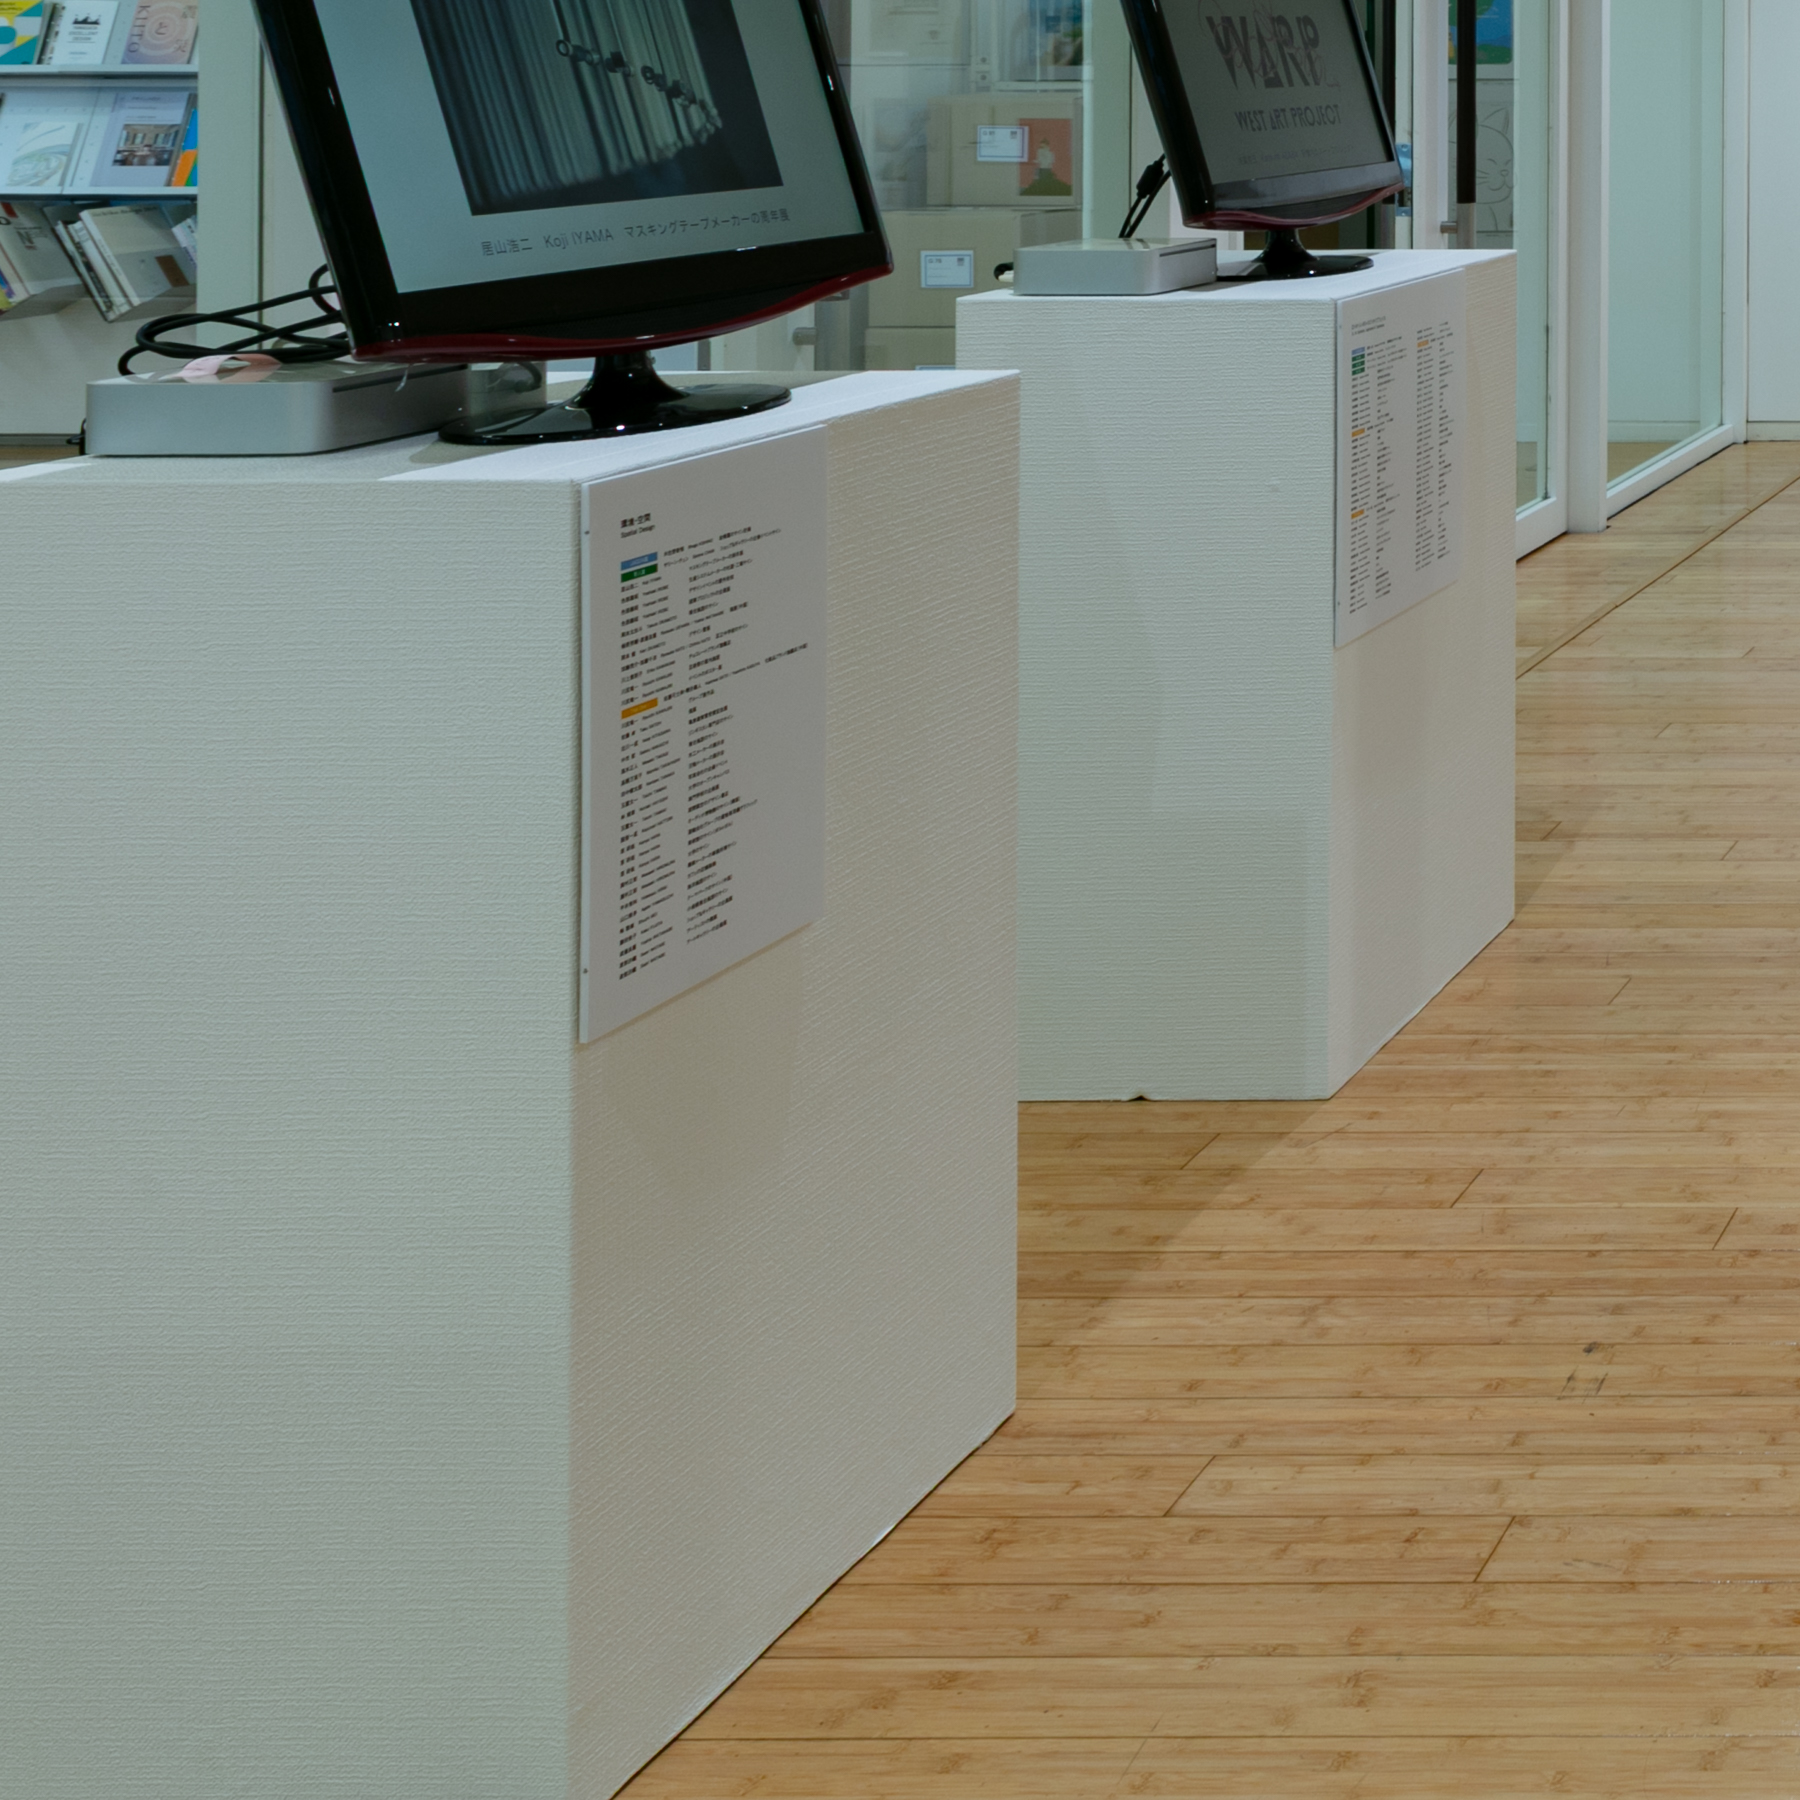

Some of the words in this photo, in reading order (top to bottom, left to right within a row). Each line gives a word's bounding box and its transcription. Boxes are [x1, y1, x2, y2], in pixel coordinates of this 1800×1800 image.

[1206, 15, 1320, 89] WARP
[1235, 107, 1268, 133] WEST
[1269, 106, 1289, 132] ART
[1290, 104, 1342, 127] PROJECT
[481, 237, 533, 256] 居山浩二
[543, 233, 569, 250] Koji
[571, 228, 615, 245] IYAMA
[624, 208, 791, 239] マスキングテープメーカーの周年展
